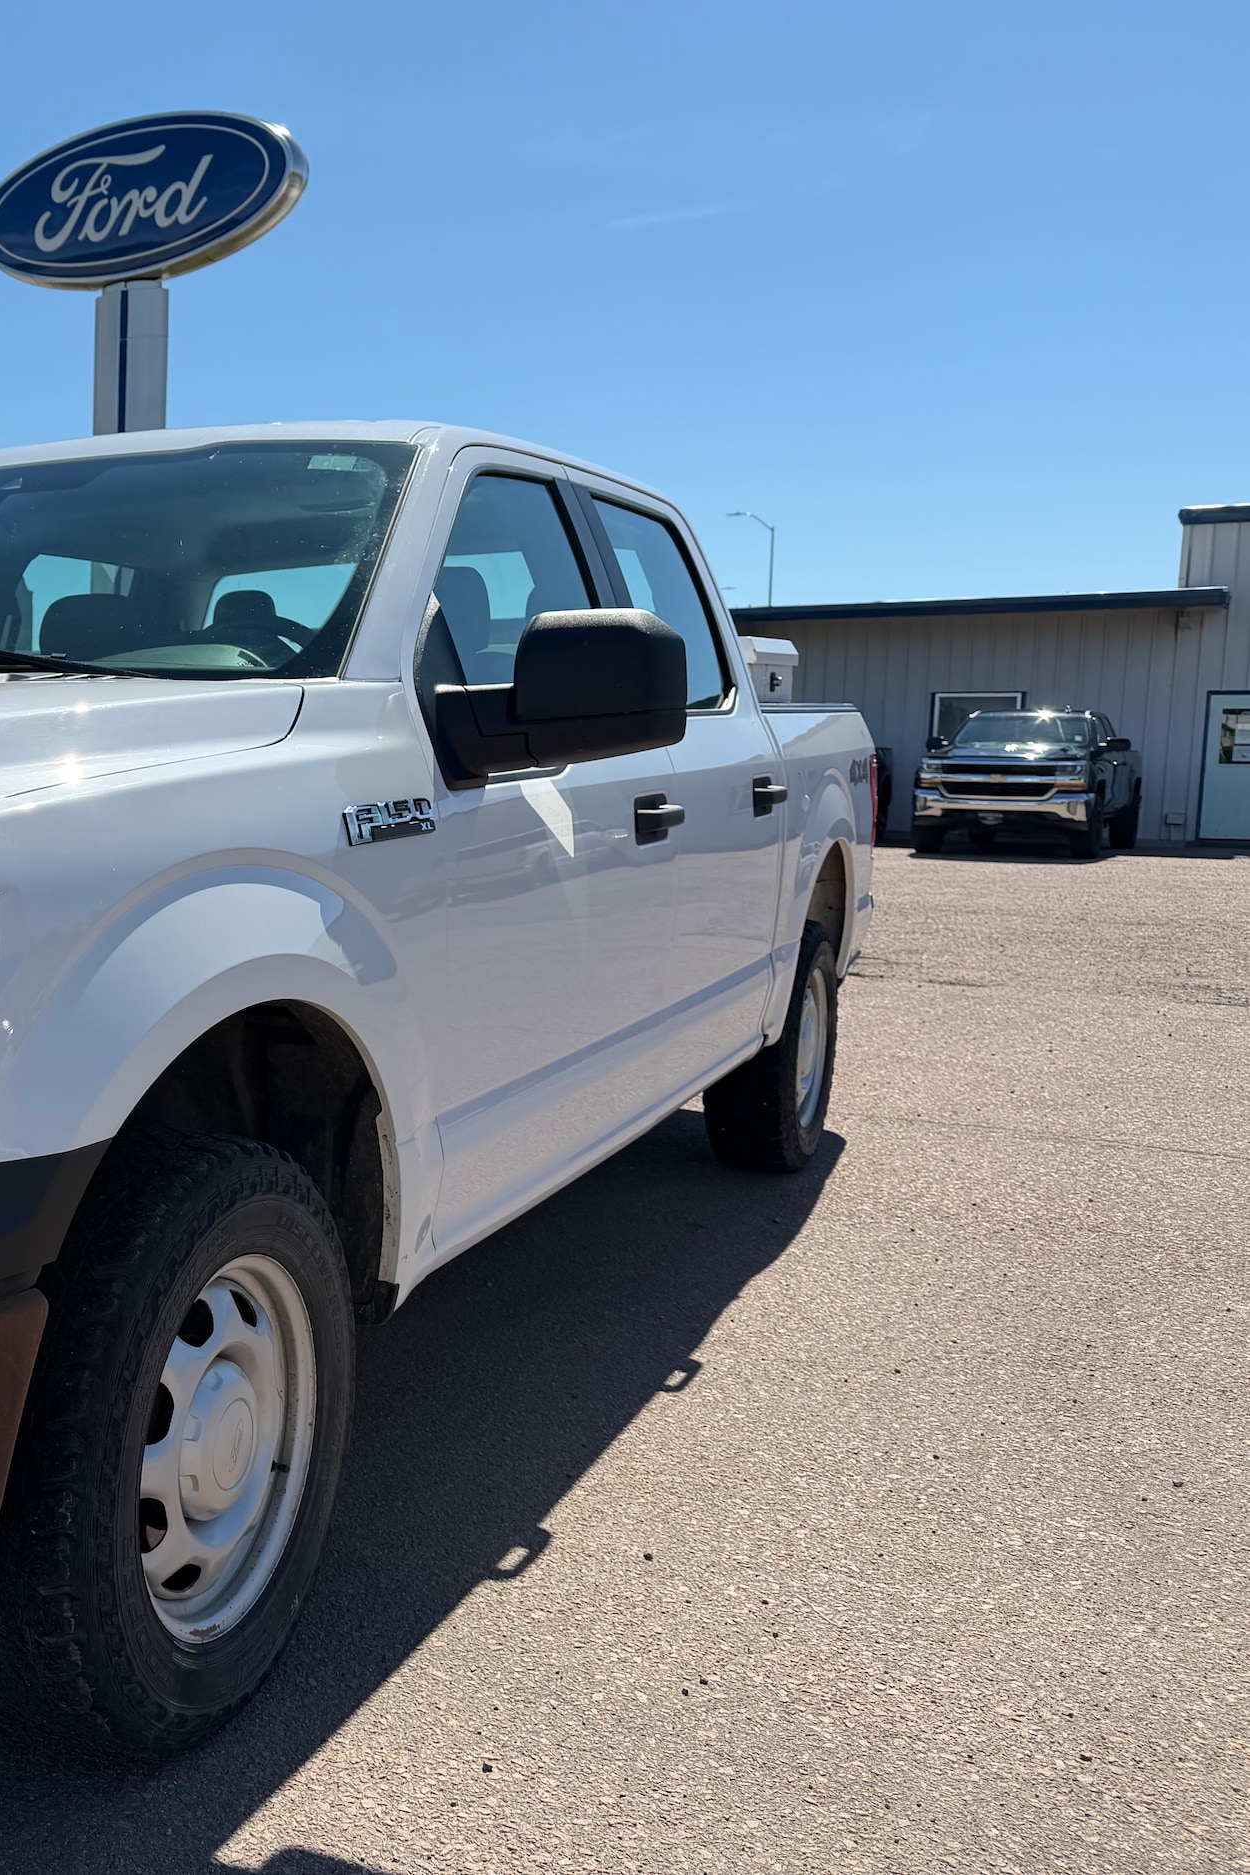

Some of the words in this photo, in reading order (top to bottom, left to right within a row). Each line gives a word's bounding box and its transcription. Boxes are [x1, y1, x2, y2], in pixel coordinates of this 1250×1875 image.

[34, 144, 214, 252] Ford
[420, 820, 434, 831] XL
[276, 1210, 348, 1367] DISCOVERER
[121, 1535, 175, 1688] COOPER
